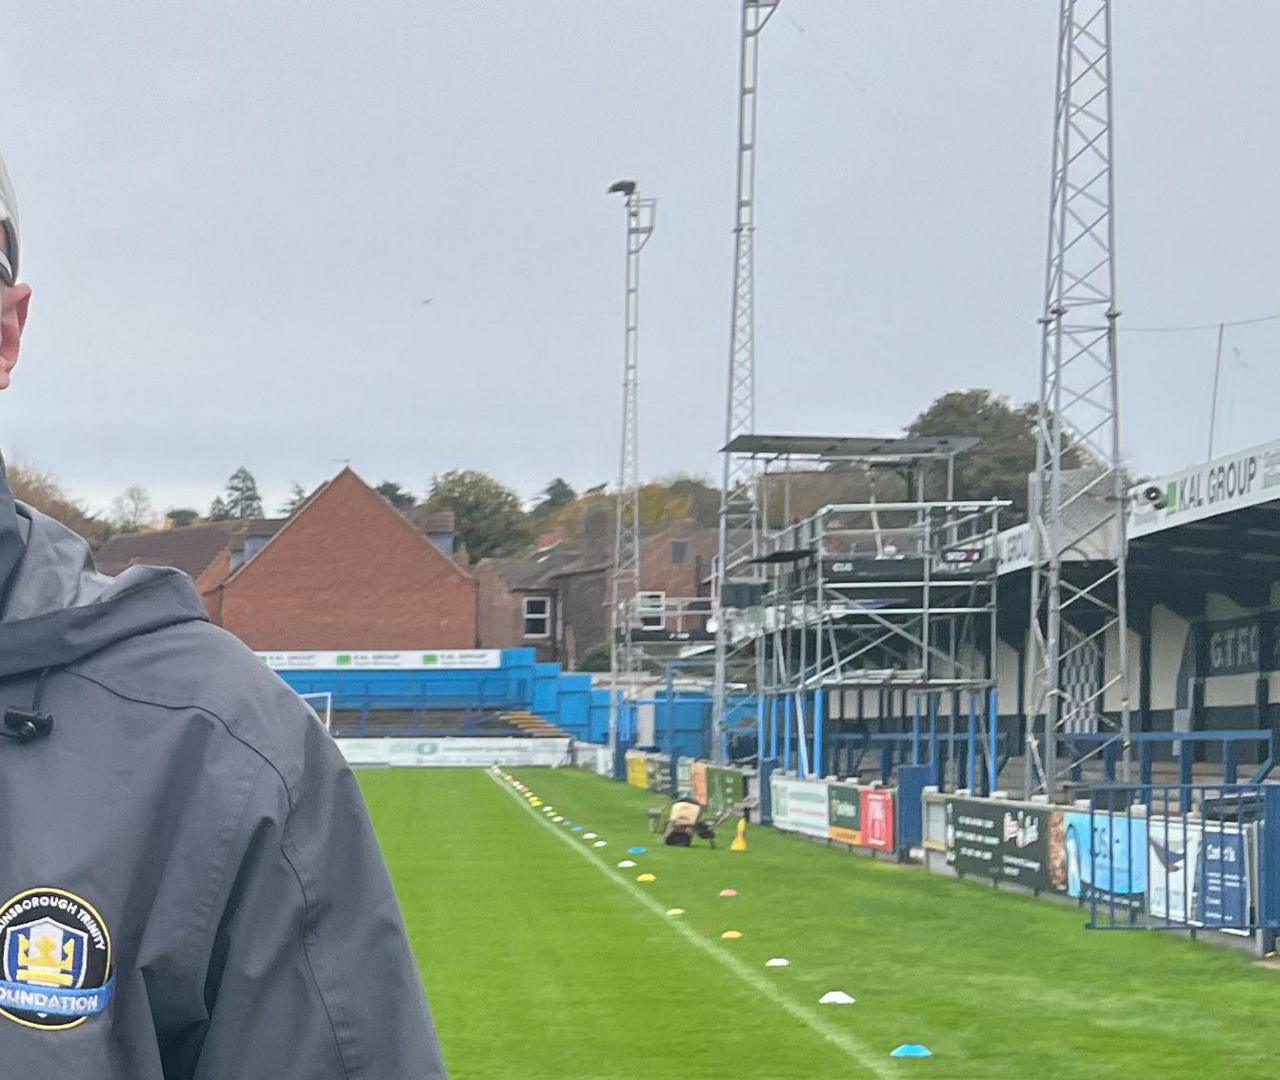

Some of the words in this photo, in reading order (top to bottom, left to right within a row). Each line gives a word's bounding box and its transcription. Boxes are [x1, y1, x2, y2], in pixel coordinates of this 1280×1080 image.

[1179, 473, 1203, 512] KAL
[1208, 455, 1257, 504] GROUP
[77, 908, 106, 950] TRINITY
